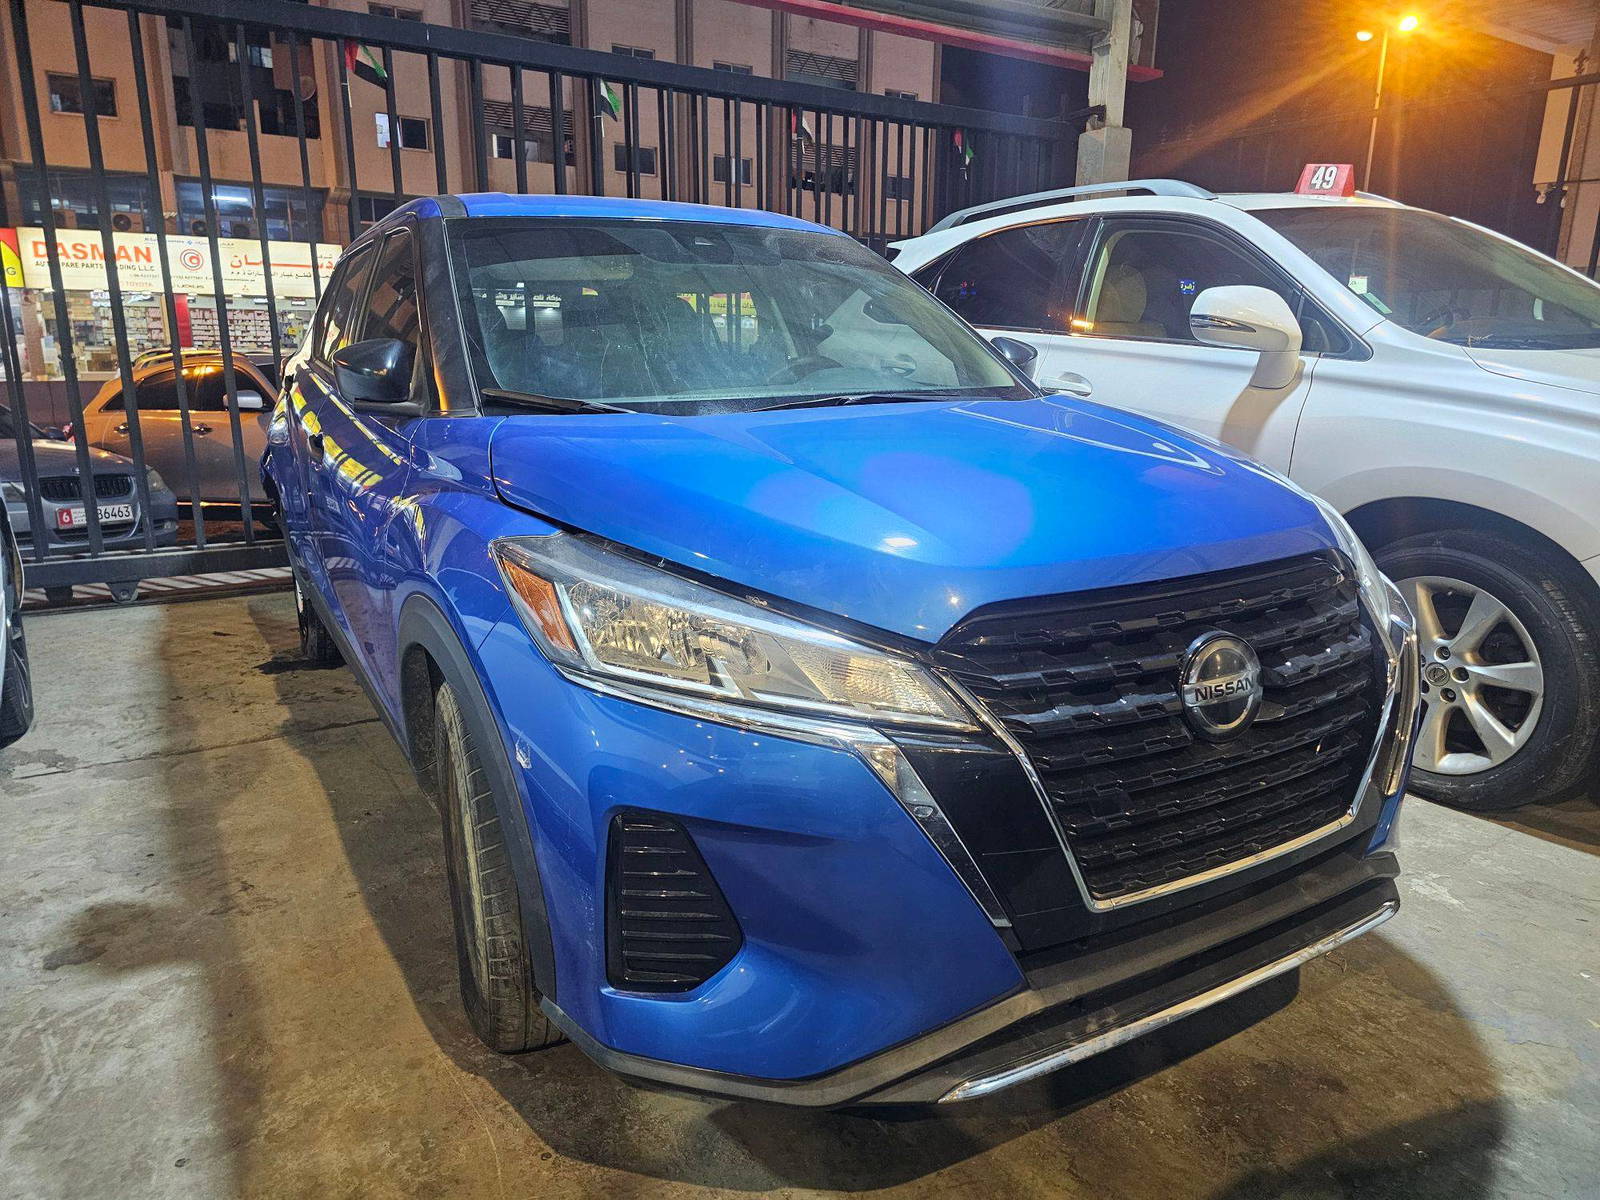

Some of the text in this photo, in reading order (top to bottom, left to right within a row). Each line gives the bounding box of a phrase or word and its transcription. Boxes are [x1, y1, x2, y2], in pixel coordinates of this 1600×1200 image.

[1311, 166, 1338, 189] 49
[32, 240, 153, 263] DASMAN
[61, 262, 79, 270] PARE
[62, 511, 71, 523] 6
[1195, 677, 1254, 702] NISSAN
